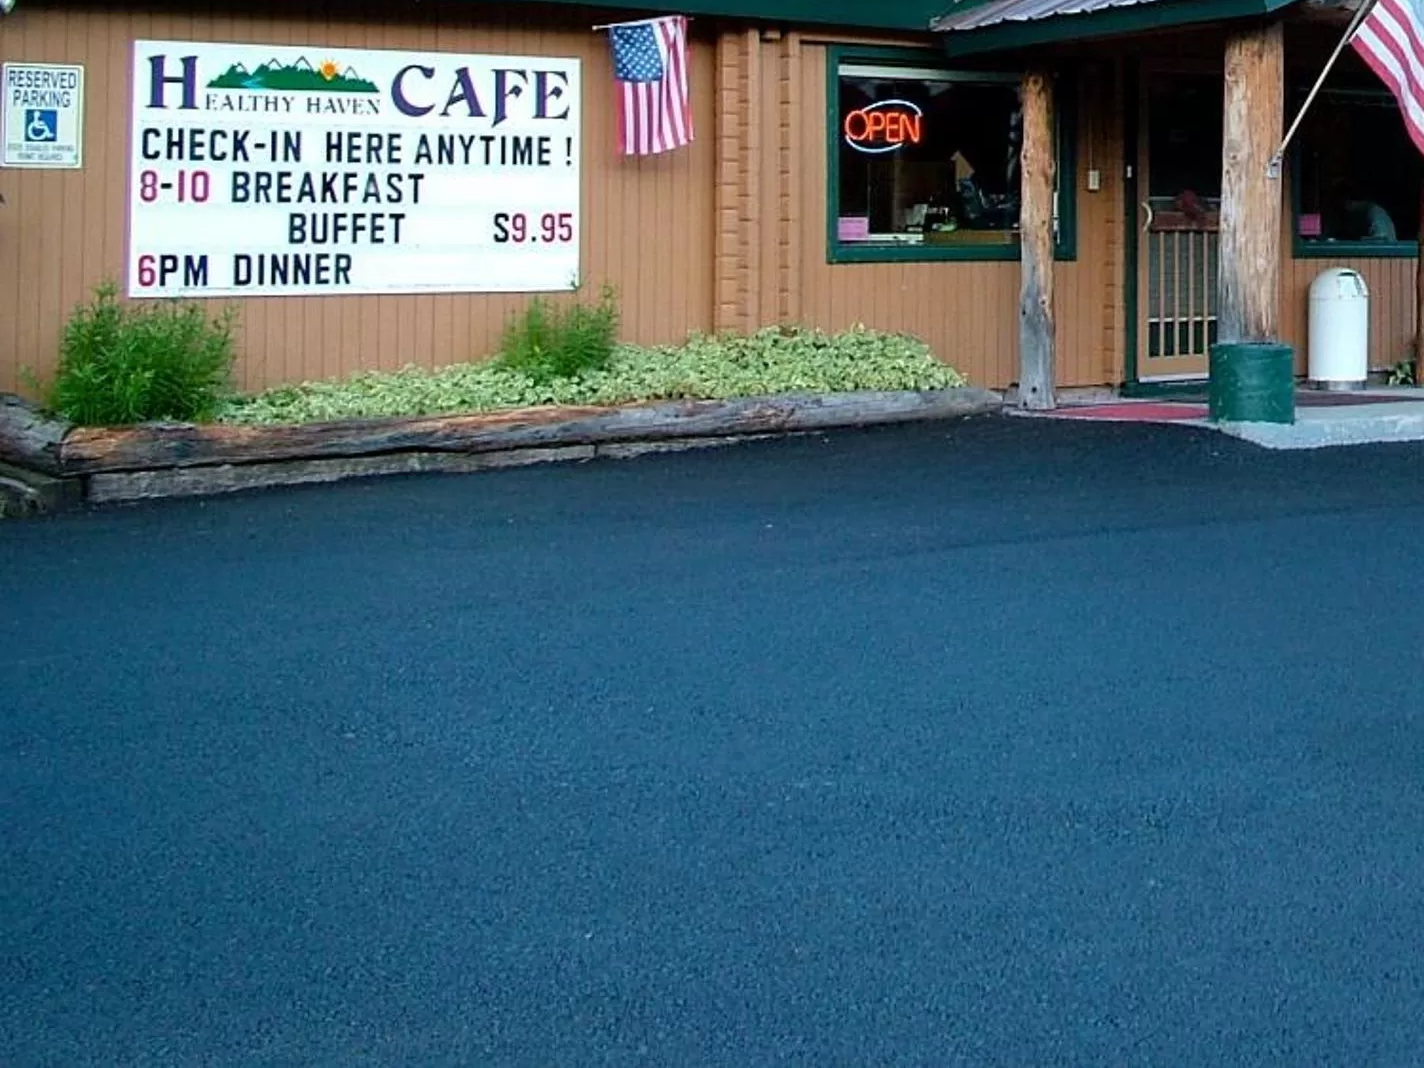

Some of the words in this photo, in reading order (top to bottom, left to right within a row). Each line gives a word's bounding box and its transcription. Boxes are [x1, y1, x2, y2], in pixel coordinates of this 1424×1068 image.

[9, 70, 77, 89] RESERVED
[145, 54, 295, 112] HEALTHY
[306, 96, 381, 116] HAVEN
[391, 64, 570, 128] CAFE
[13, 89, 71, 108] PARKING
[845, 110, 920, 143] OPEN
[142, 127, 302, 162] CHECK-IN
[326, 131, 402, 163] HERE
[140, 170, 209, 203] 8-10
[231, 171, 424, 204] BREAKFAST
[288, 213, 405, 244] BUFFET
[138, 254, 208, 287] 6PM
[233, 254, 352, 286] DINNER
